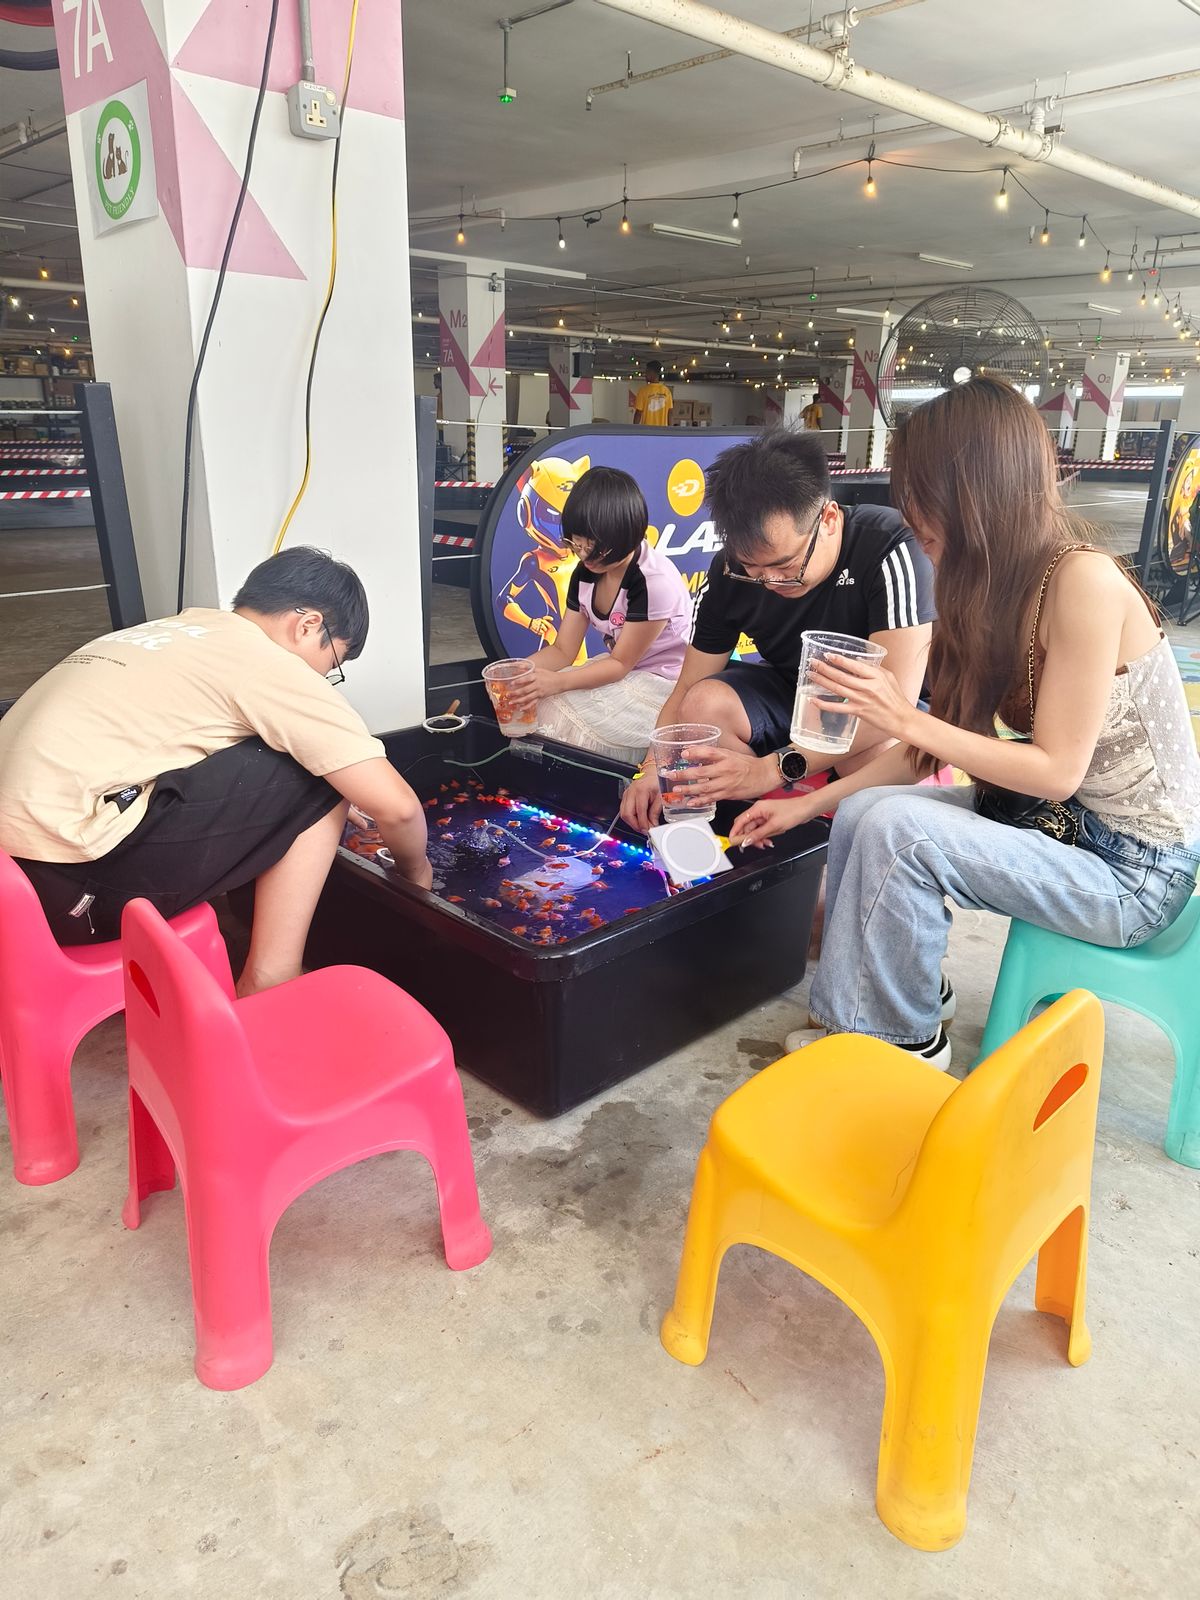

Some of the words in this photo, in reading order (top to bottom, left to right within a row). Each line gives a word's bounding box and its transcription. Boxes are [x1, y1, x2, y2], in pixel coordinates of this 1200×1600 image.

[63, 0, 114, 79] 7A
[112, 186, 135, 215] FRIENDLY
[450, 309, 468, 328] M2
[443, 349, 455, 363] 7A
[864, 350, 880, 363] N2
[855, 376, 866, 386] 7A
[1097, 373, 1111, 384] O2
